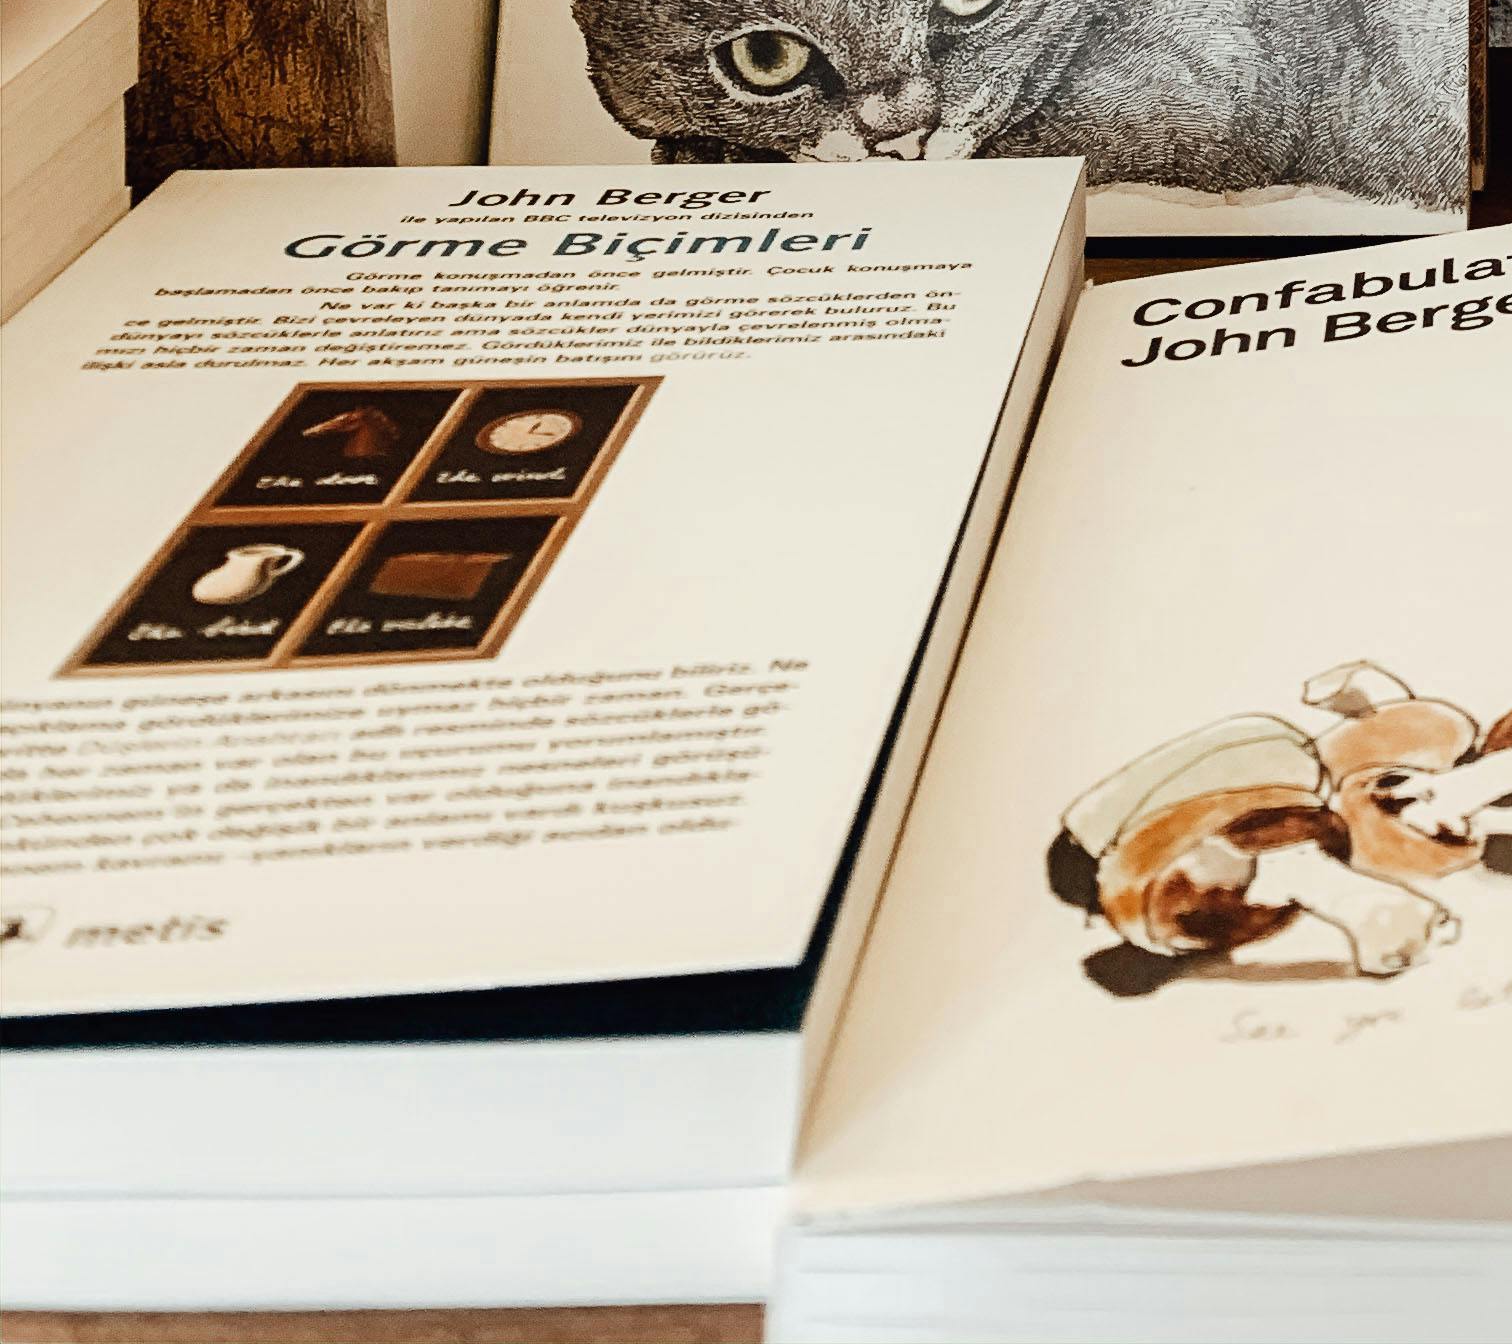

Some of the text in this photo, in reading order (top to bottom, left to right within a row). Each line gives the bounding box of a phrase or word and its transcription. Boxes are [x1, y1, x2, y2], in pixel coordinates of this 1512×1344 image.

[448, 187, 772, 209] John Berger
[399, 215, 427, 224] ile
[523, 214, 572, 223] BBC
[578, 213, 692, 223] televizyon
[700, 210, 814, 220] dizisinden
[284, 227, 872, 263] Görme Biçimleri
[346, 272, 423, 281] Görme
[434, 270, 576, 281] konuşmadan
[587, 269, 641, 279] önce
[767, 265, 834, 276] Çocuk
[846, 262, 973, 273] konuşmaya
[154, 286, 293, 297] başlamadan
[300, 285, 354, 295] önce
[319, 301, 352, 310] Ne
[360, 302, 395, 310] var
[404, 301, 423, 309] ki
[430, 300, 496, 310] başka
[504, 300, 535, 309] bir
[543, 298, 641, 308] anlamda
[650, 297, 676, 306] da
[685, 296, 759, 307] görme
[560, 312, 623, 321] kendi
[926, 303, 957, 311] Bu
[1121, 323, 1296, 369] John
